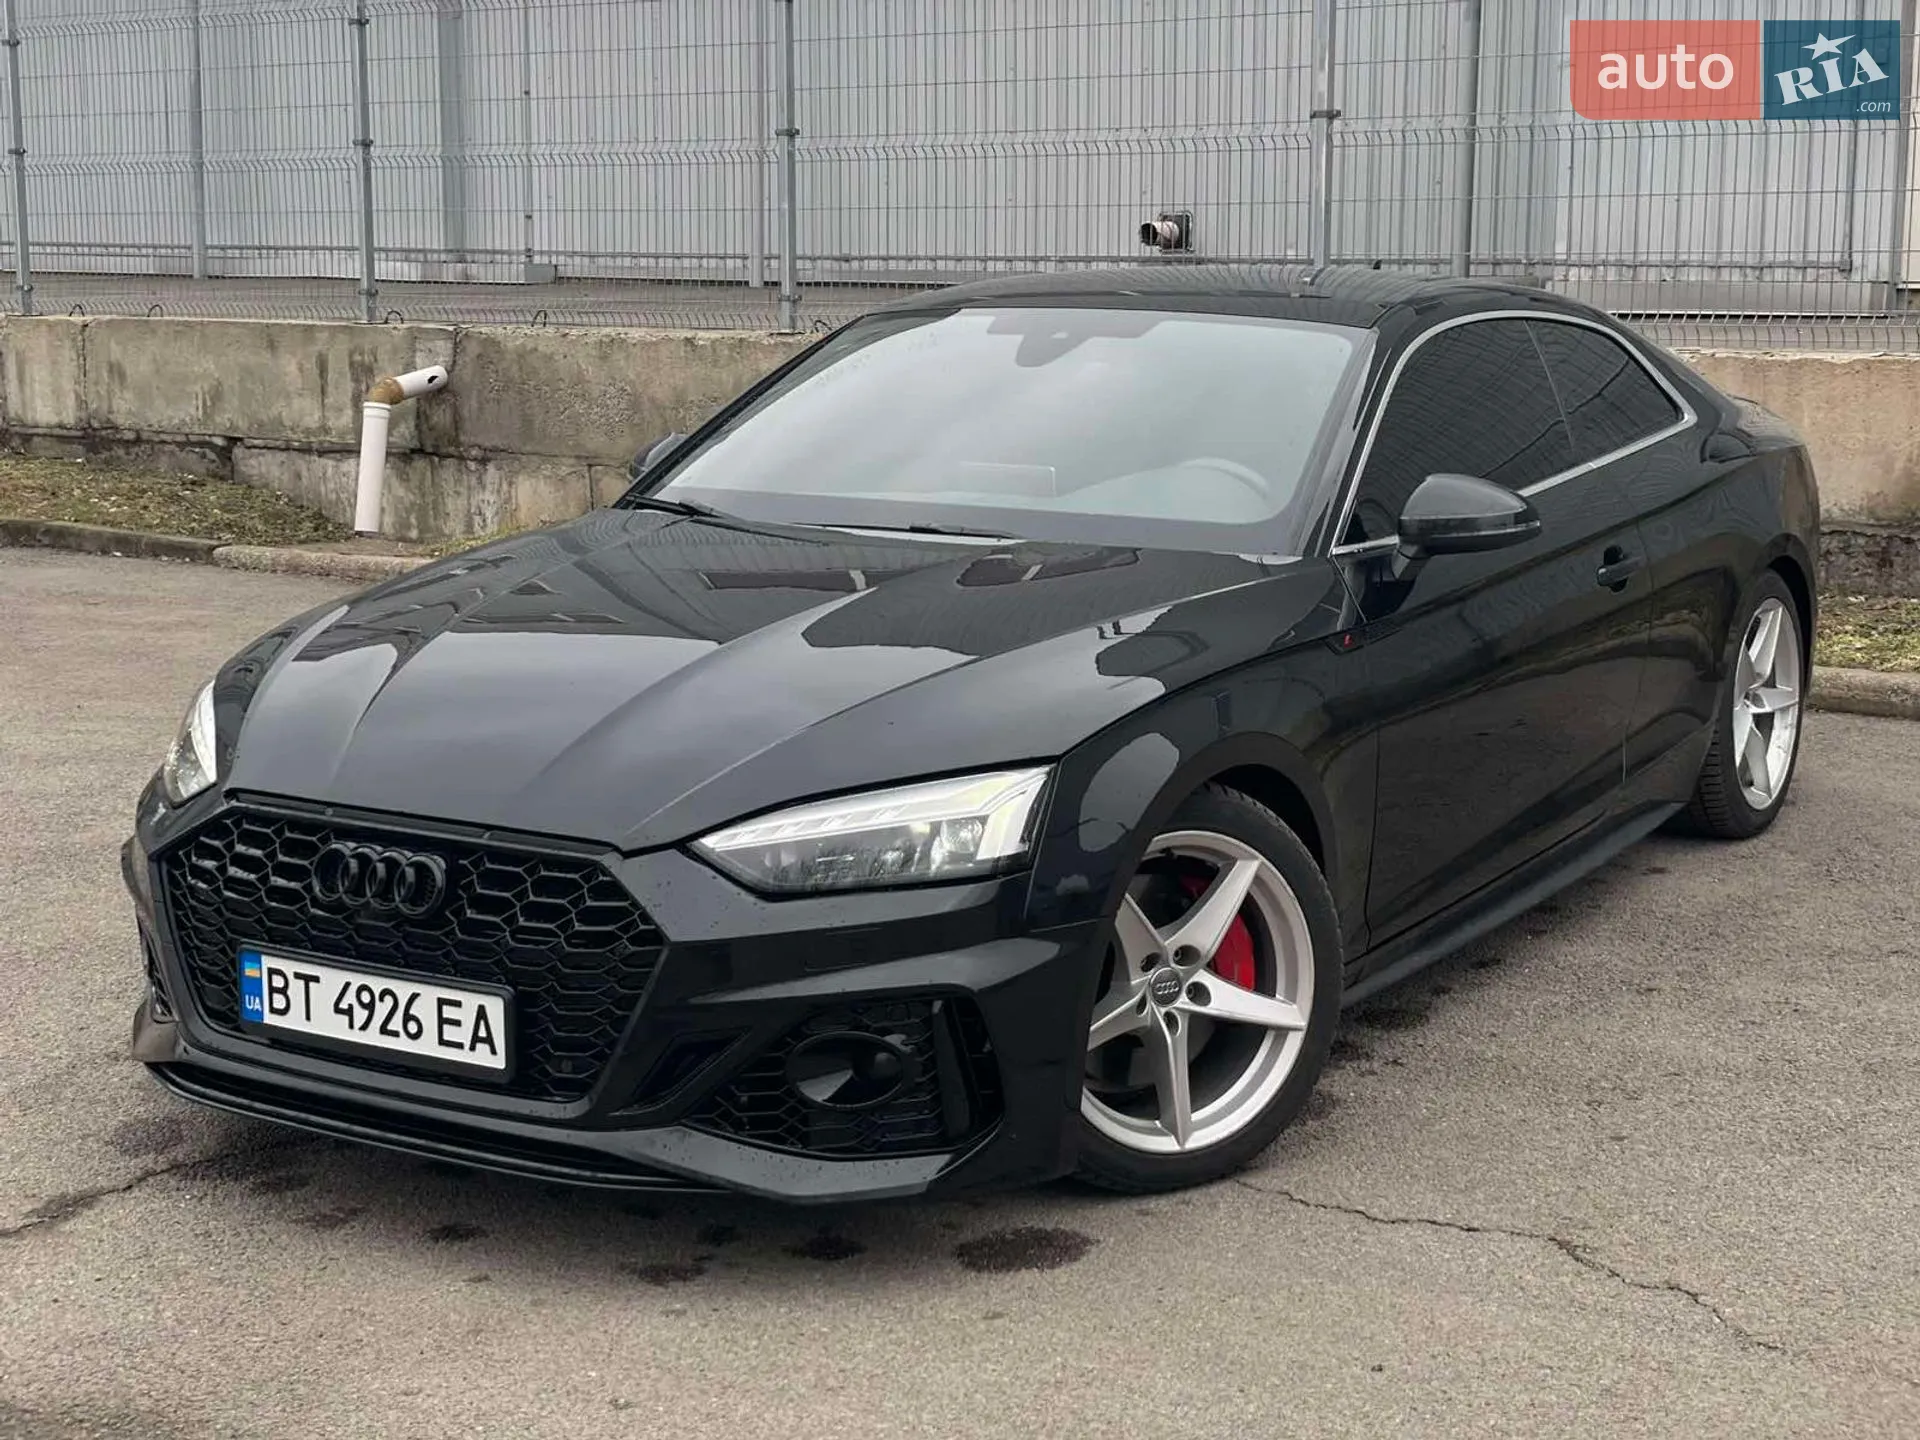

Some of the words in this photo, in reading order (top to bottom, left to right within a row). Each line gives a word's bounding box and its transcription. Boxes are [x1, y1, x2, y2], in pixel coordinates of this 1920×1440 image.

[245, 994, 262, 1012] UA
[267, 966, 320, 1022] BT
[333, 981, 424, 1041] 4926
[436, 996, 498, 1056] EA
